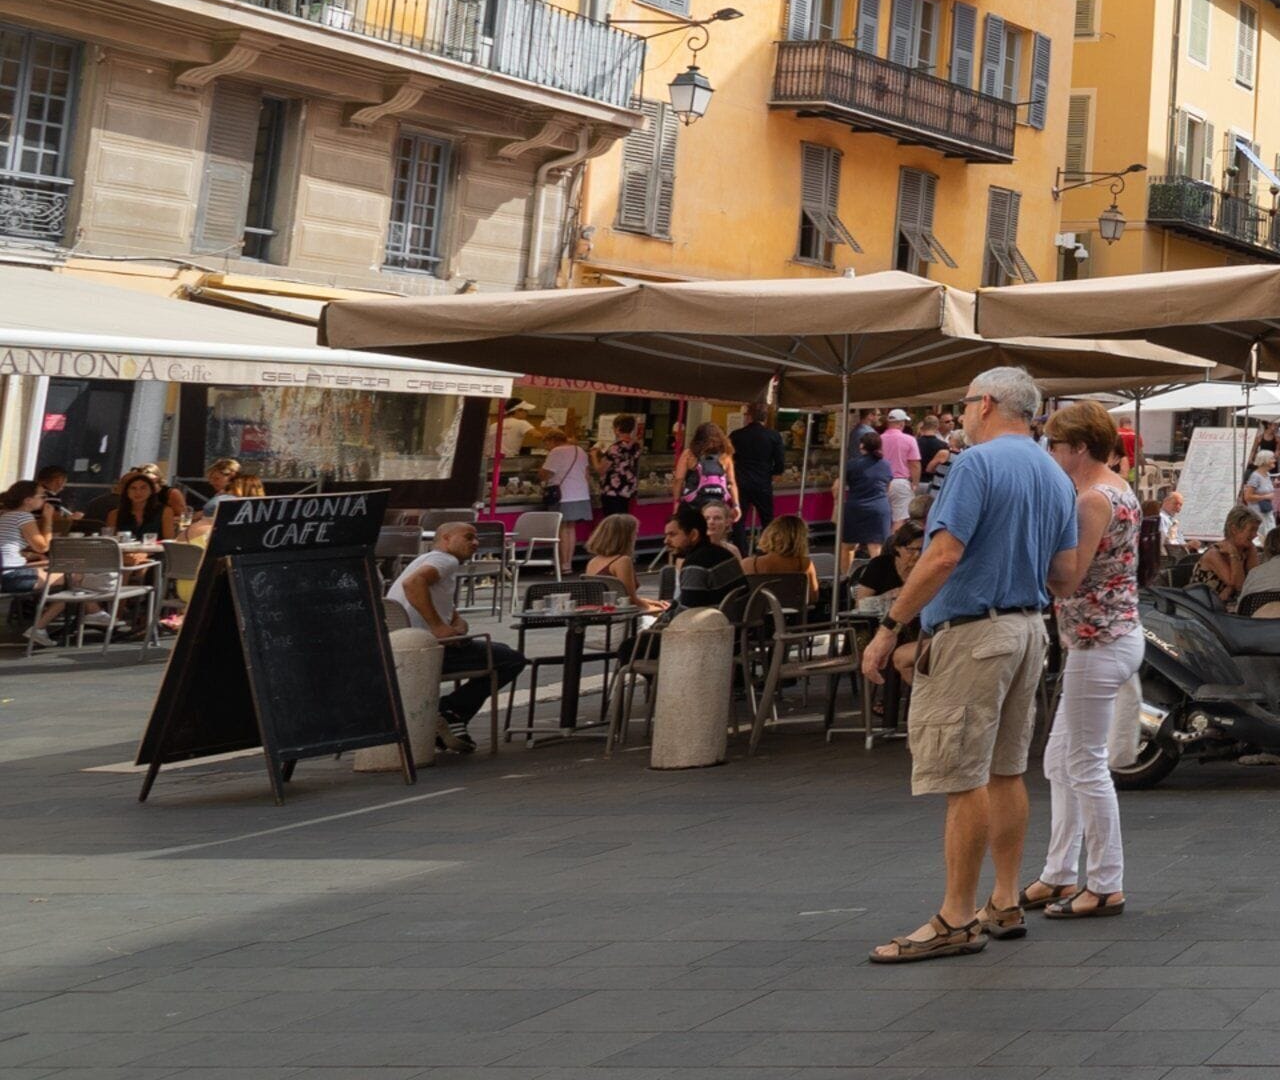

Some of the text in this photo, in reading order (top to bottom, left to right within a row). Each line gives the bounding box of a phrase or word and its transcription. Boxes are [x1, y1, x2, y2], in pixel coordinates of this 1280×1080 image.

[0, 348, 159, 380] ANTONA
[262, 370, 504, 394] GELATERIA CREPERIE
[228, 495, 369, 525] ANTIONIA
